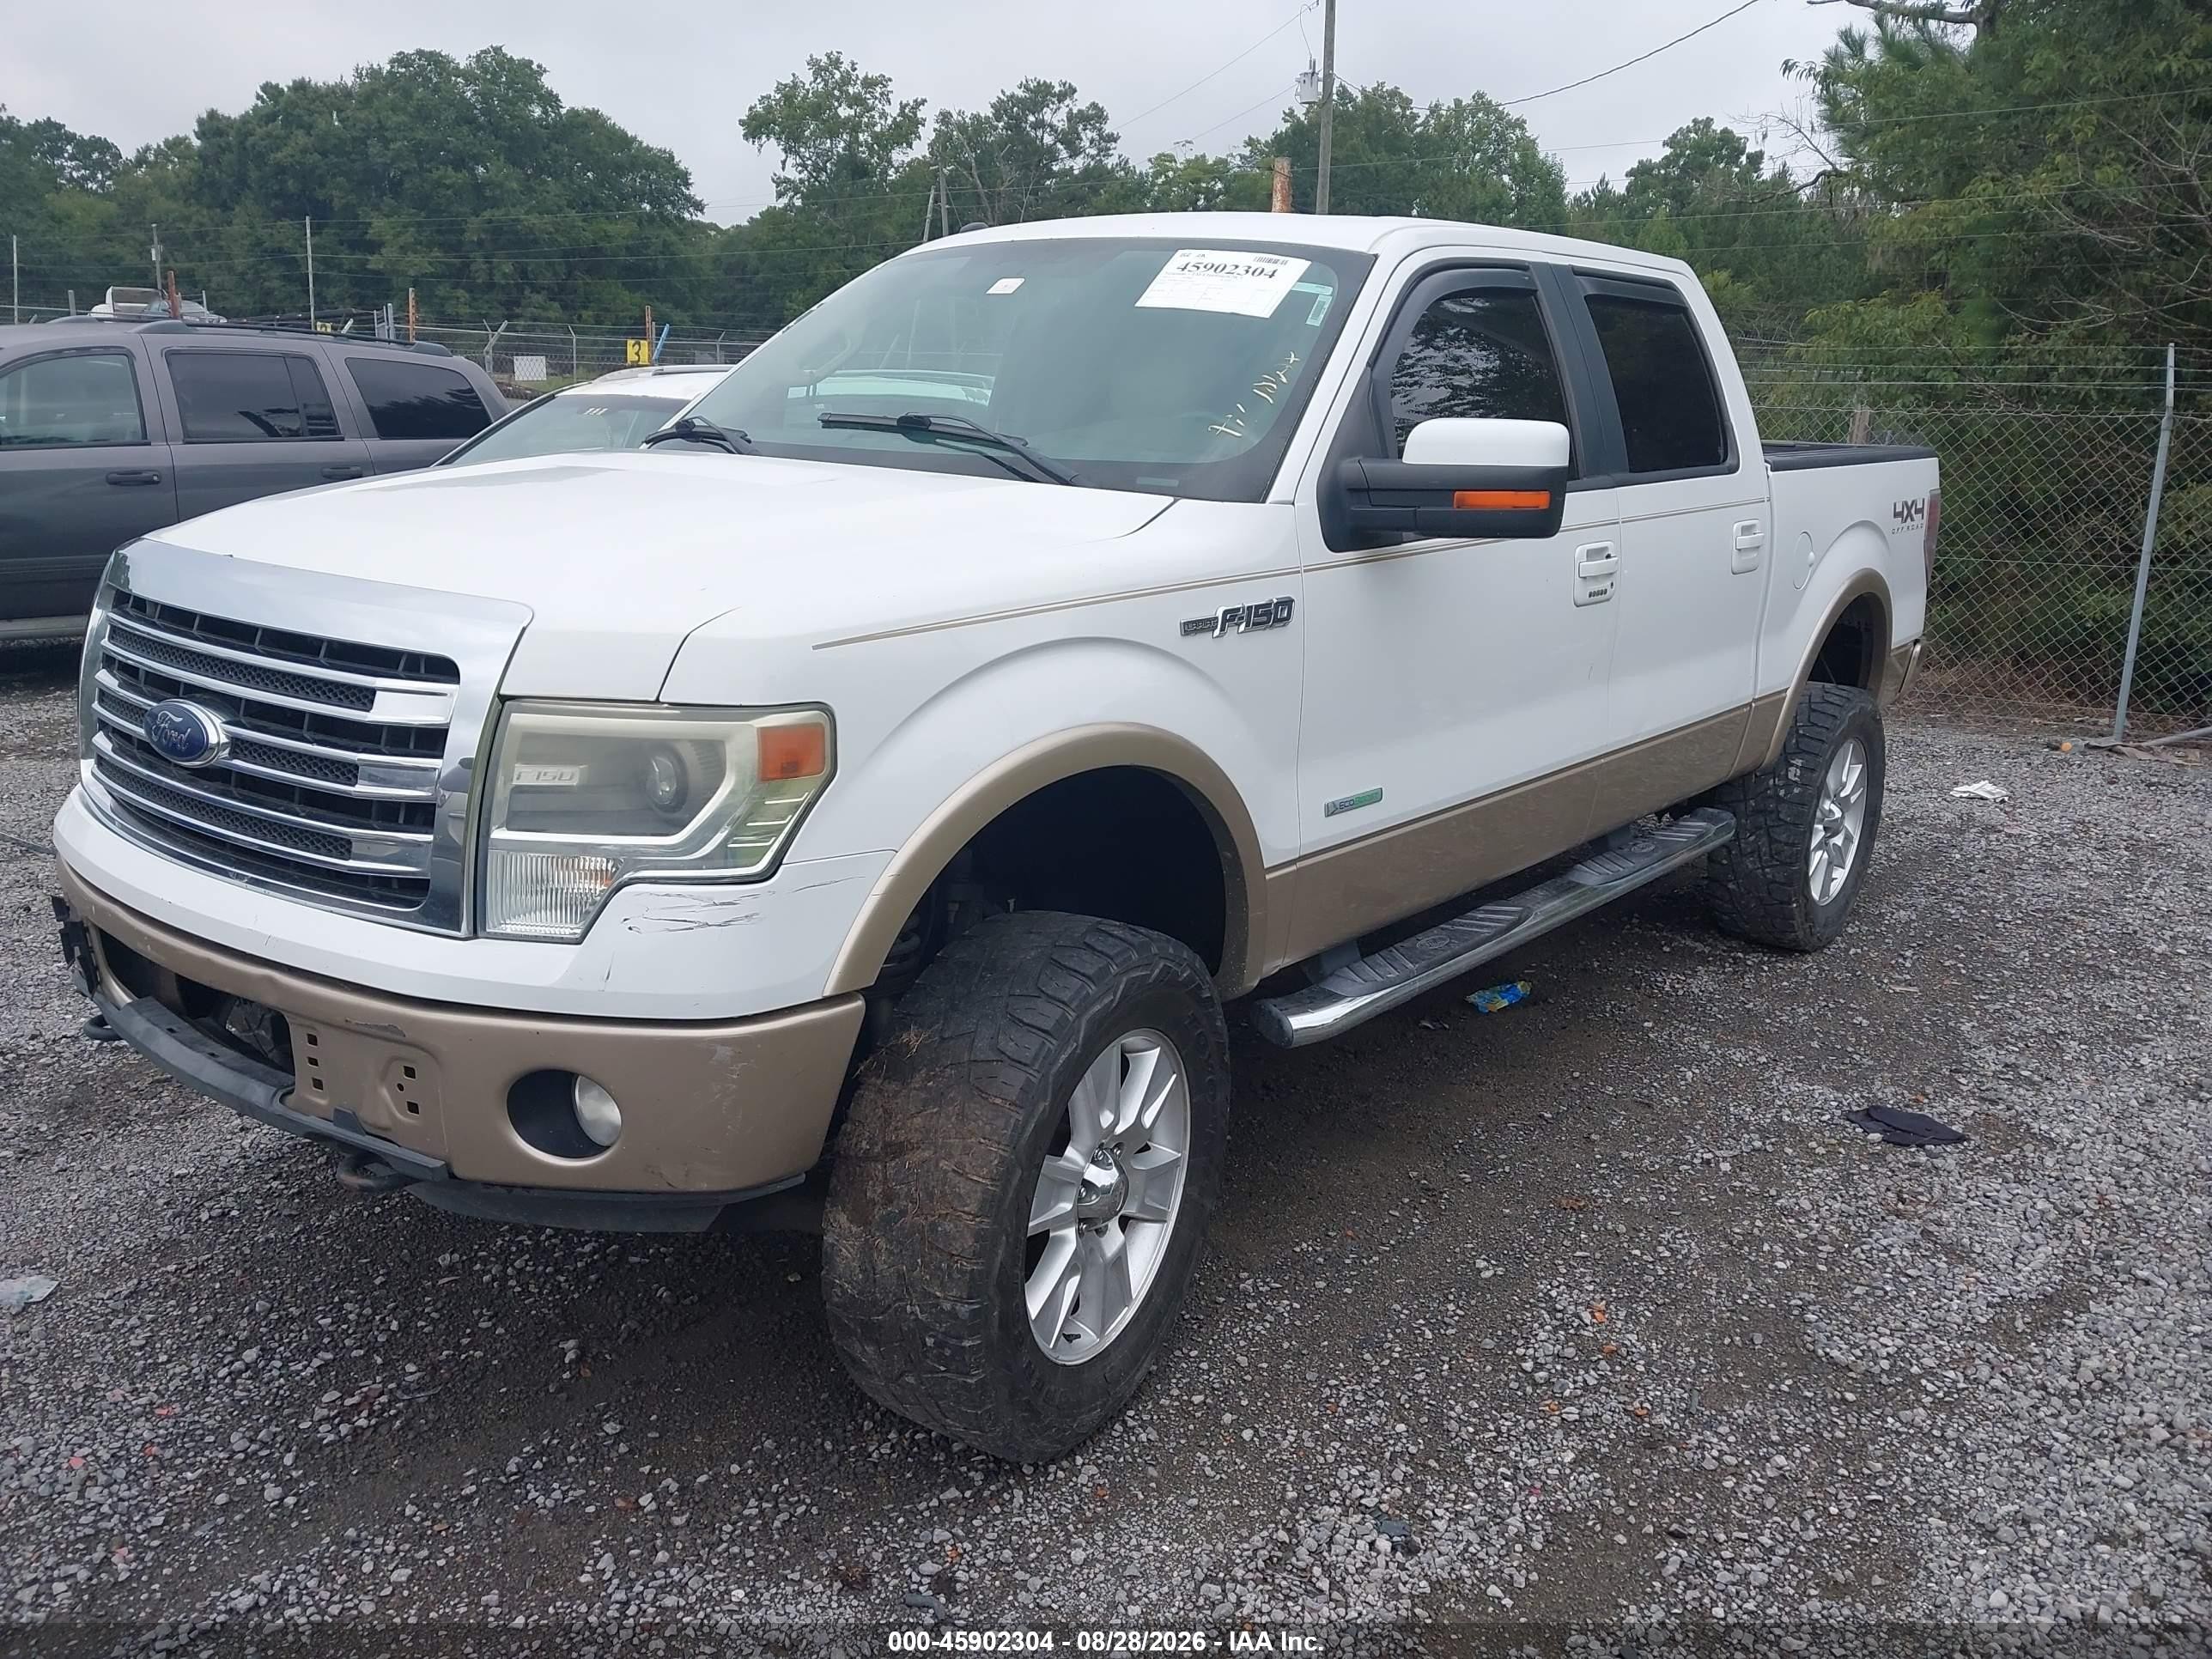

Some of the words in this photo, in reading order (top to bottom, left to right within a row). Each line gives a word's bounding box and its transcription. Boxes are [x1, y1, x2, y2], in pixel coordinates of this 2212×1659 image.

[1176, 262, 1278, 279] 45902304
[631, 341, 641, 363] 3
[152, 710, 191, 750] Ford
